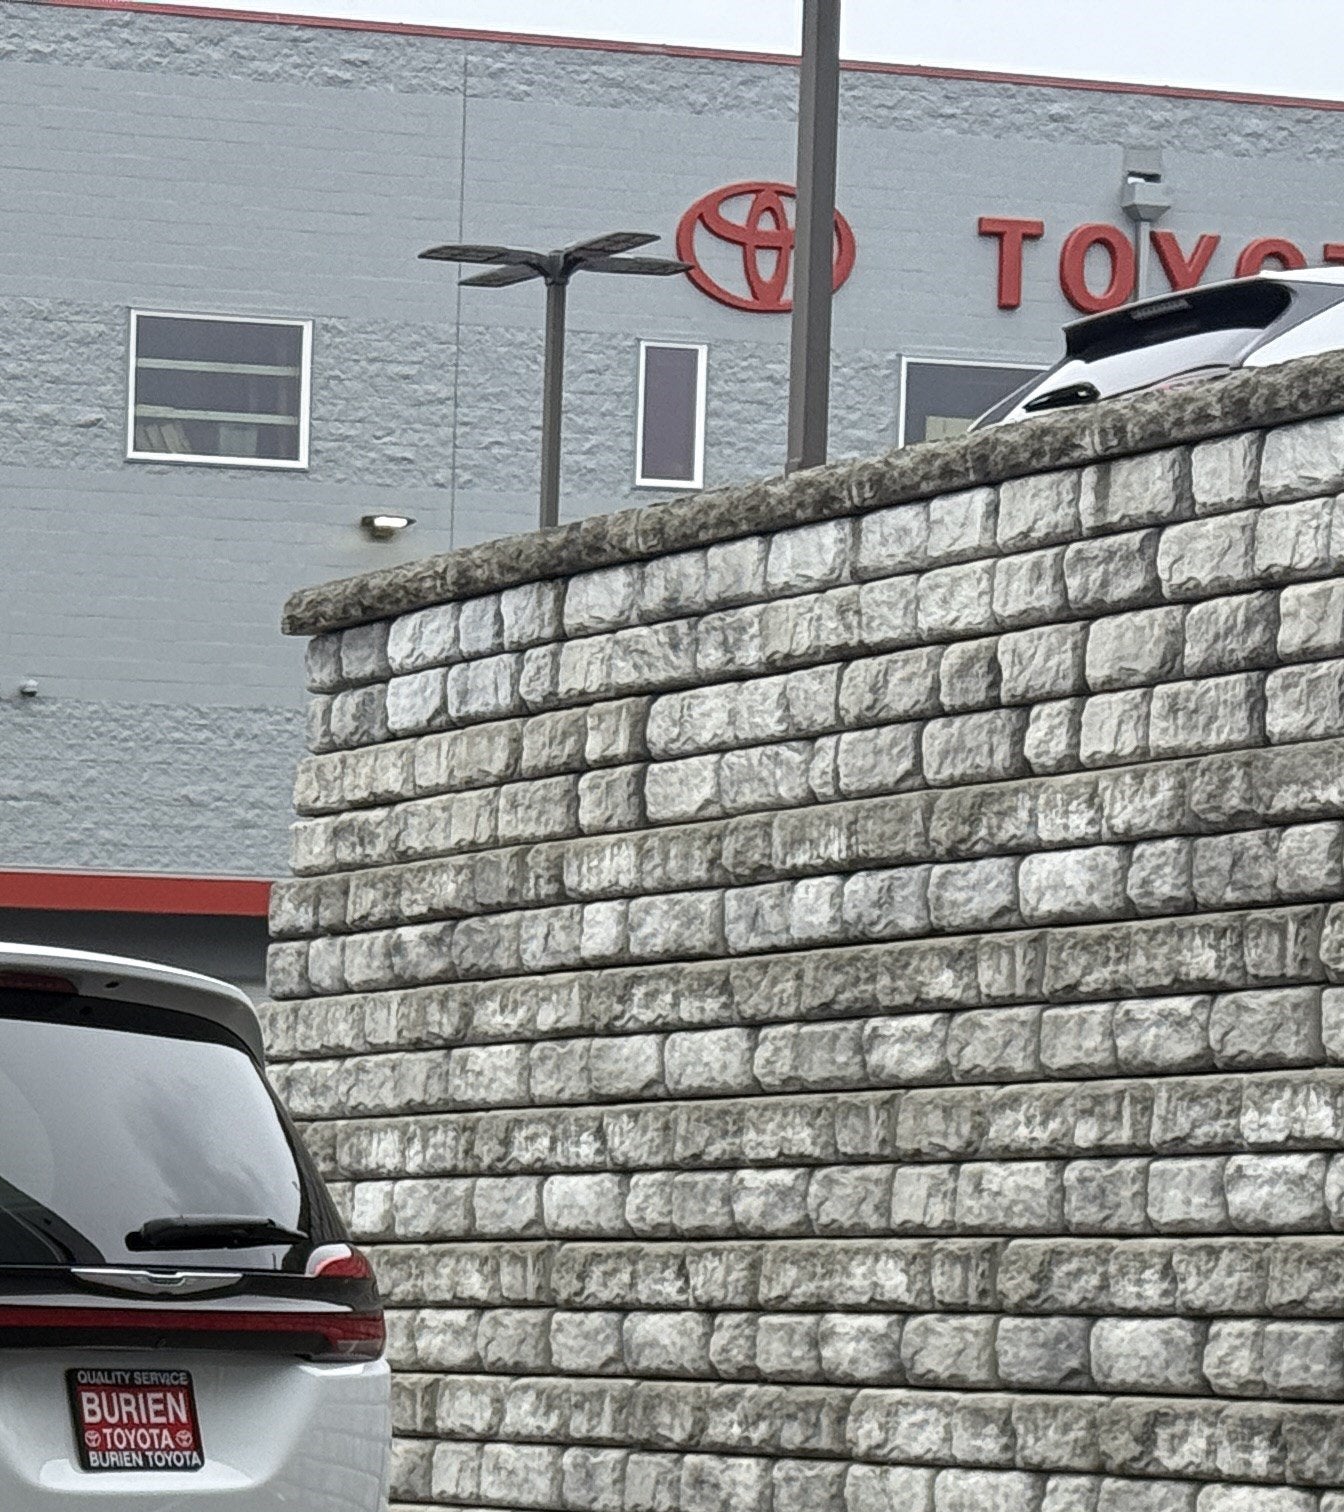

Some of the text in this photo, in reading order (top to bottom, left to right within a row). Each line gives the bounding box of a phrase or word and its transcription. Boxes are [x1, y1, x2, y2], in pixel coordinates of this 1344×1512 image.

[978, 215, 1344, 313] TOY
[77, 1370, 189, 1386] QUALITY SERVICE
[80, 1391, 189, 1424] BURIEN
[102, 1428, 176, 1450] TOYOTA
[89, 1451, 202, 1467] BURIEN TOYOTA
